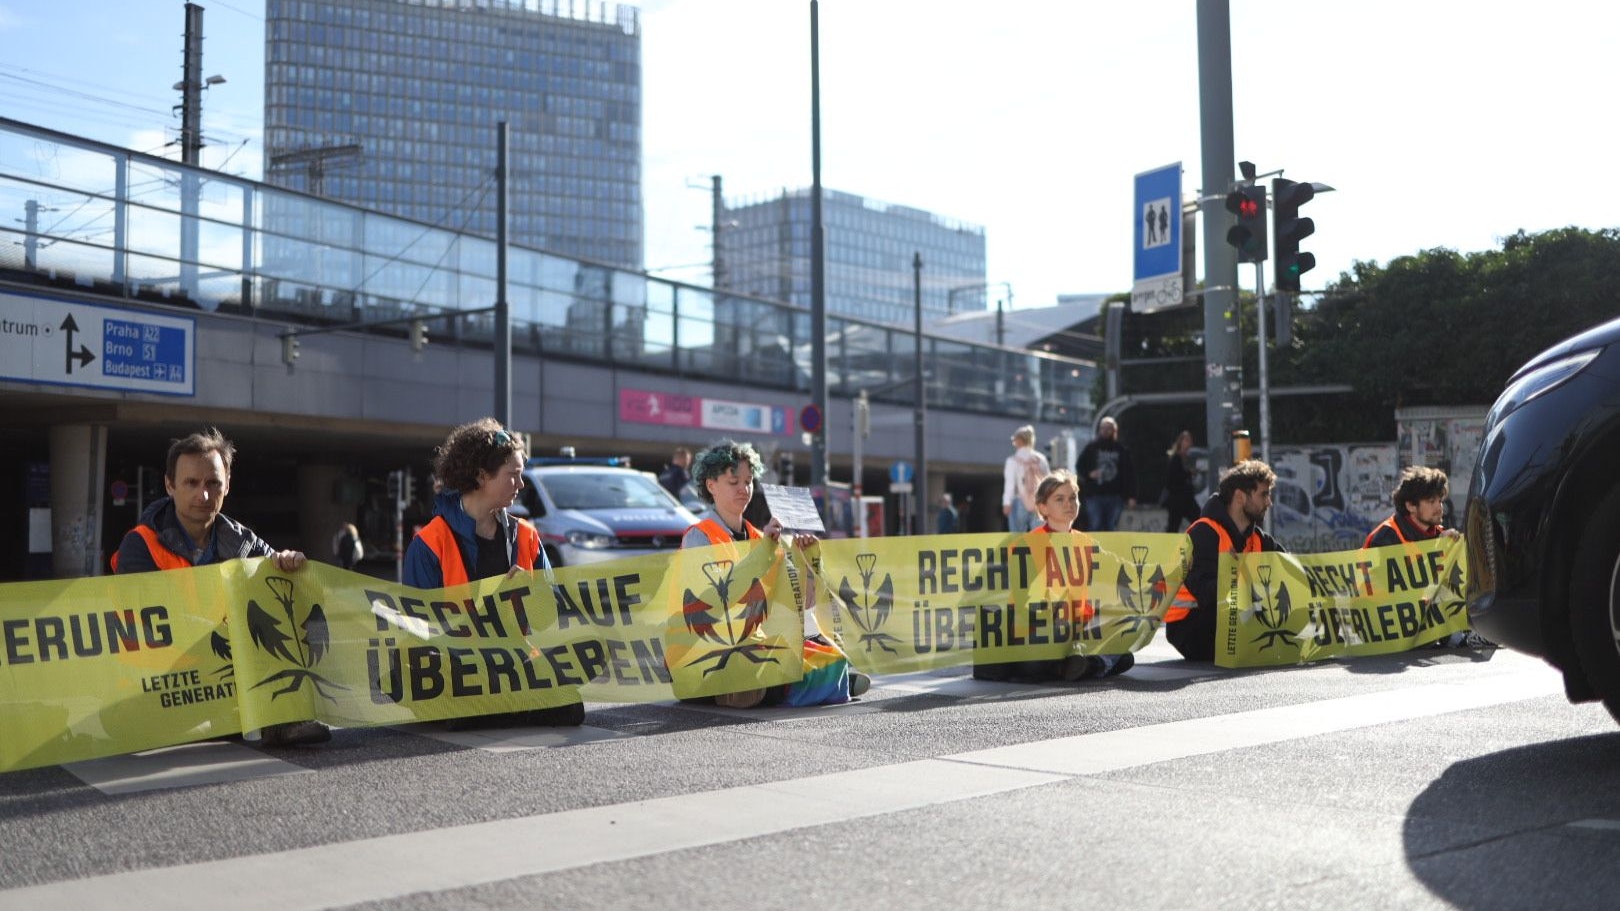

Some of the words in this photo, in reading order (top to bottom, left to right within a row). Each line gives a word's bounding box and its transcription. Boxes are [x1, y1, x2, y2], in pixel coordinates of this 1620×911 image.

[0, 319, 38, 336] trum
[105, 341, 133, 357] Brno
[106, 322, 140, 339] Praha
[105, 360, 151, 378] Budapest
[918, 546, 1032, 594] RECHT
[1046, 545, 1100, 587] AUF
[1303, 561, 1374, 598] RECHT
[1386, 551, 1445, 593] AUF
[364, 586, 532, 638] RECHT
[552, 573, 642, 629] AUF
[912, 599, 1102, 654] ÜBERLEBEN
[0, 605, 173, 667] ERUNG
[141, 670, 201, 693] LETZTE
[366, 637, 674, 705] ÜBERLEBEN
